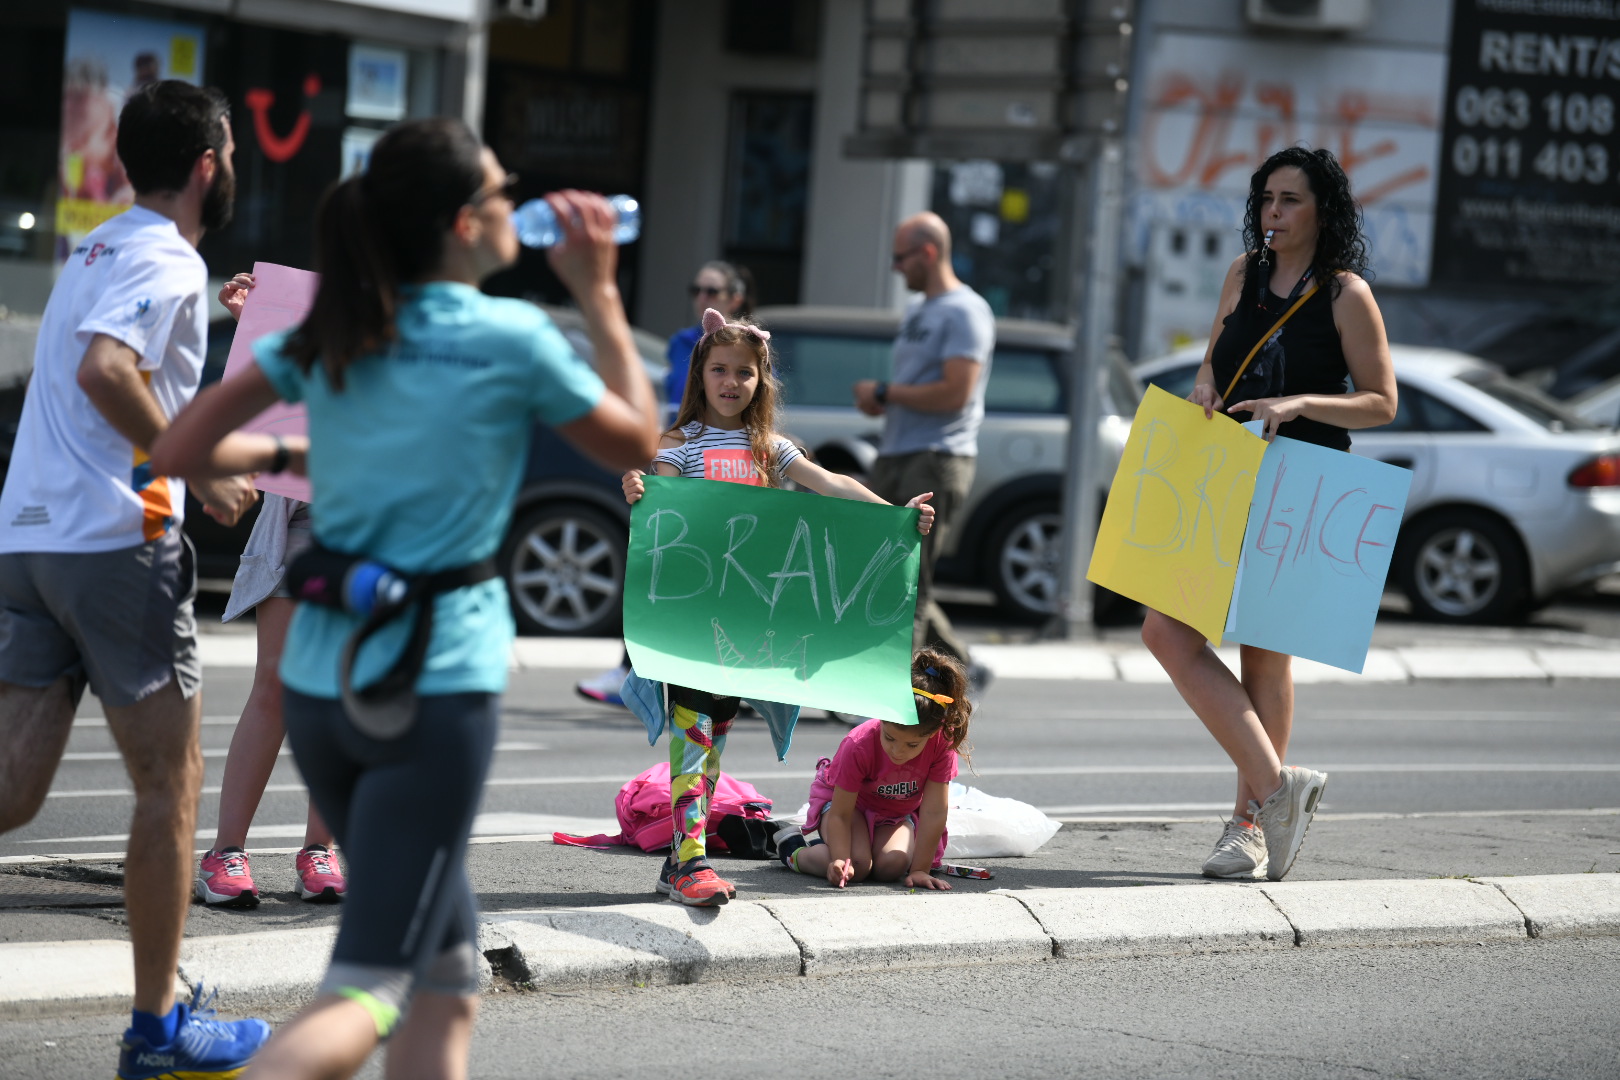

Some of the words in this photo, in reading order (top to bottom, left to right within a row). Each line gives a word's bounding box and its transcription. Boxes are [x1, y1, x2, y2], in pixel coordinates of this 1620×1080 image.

[1455, 85, 1530, 130] 063
[1542, 90, 1615, 135] 108
[1452, 134, 1522, 179] 011
[1533, 140, 1610, 184] 403
[710, 458, 768, 479] FRIDA
[646, 507, 917, 627] BRAVO
